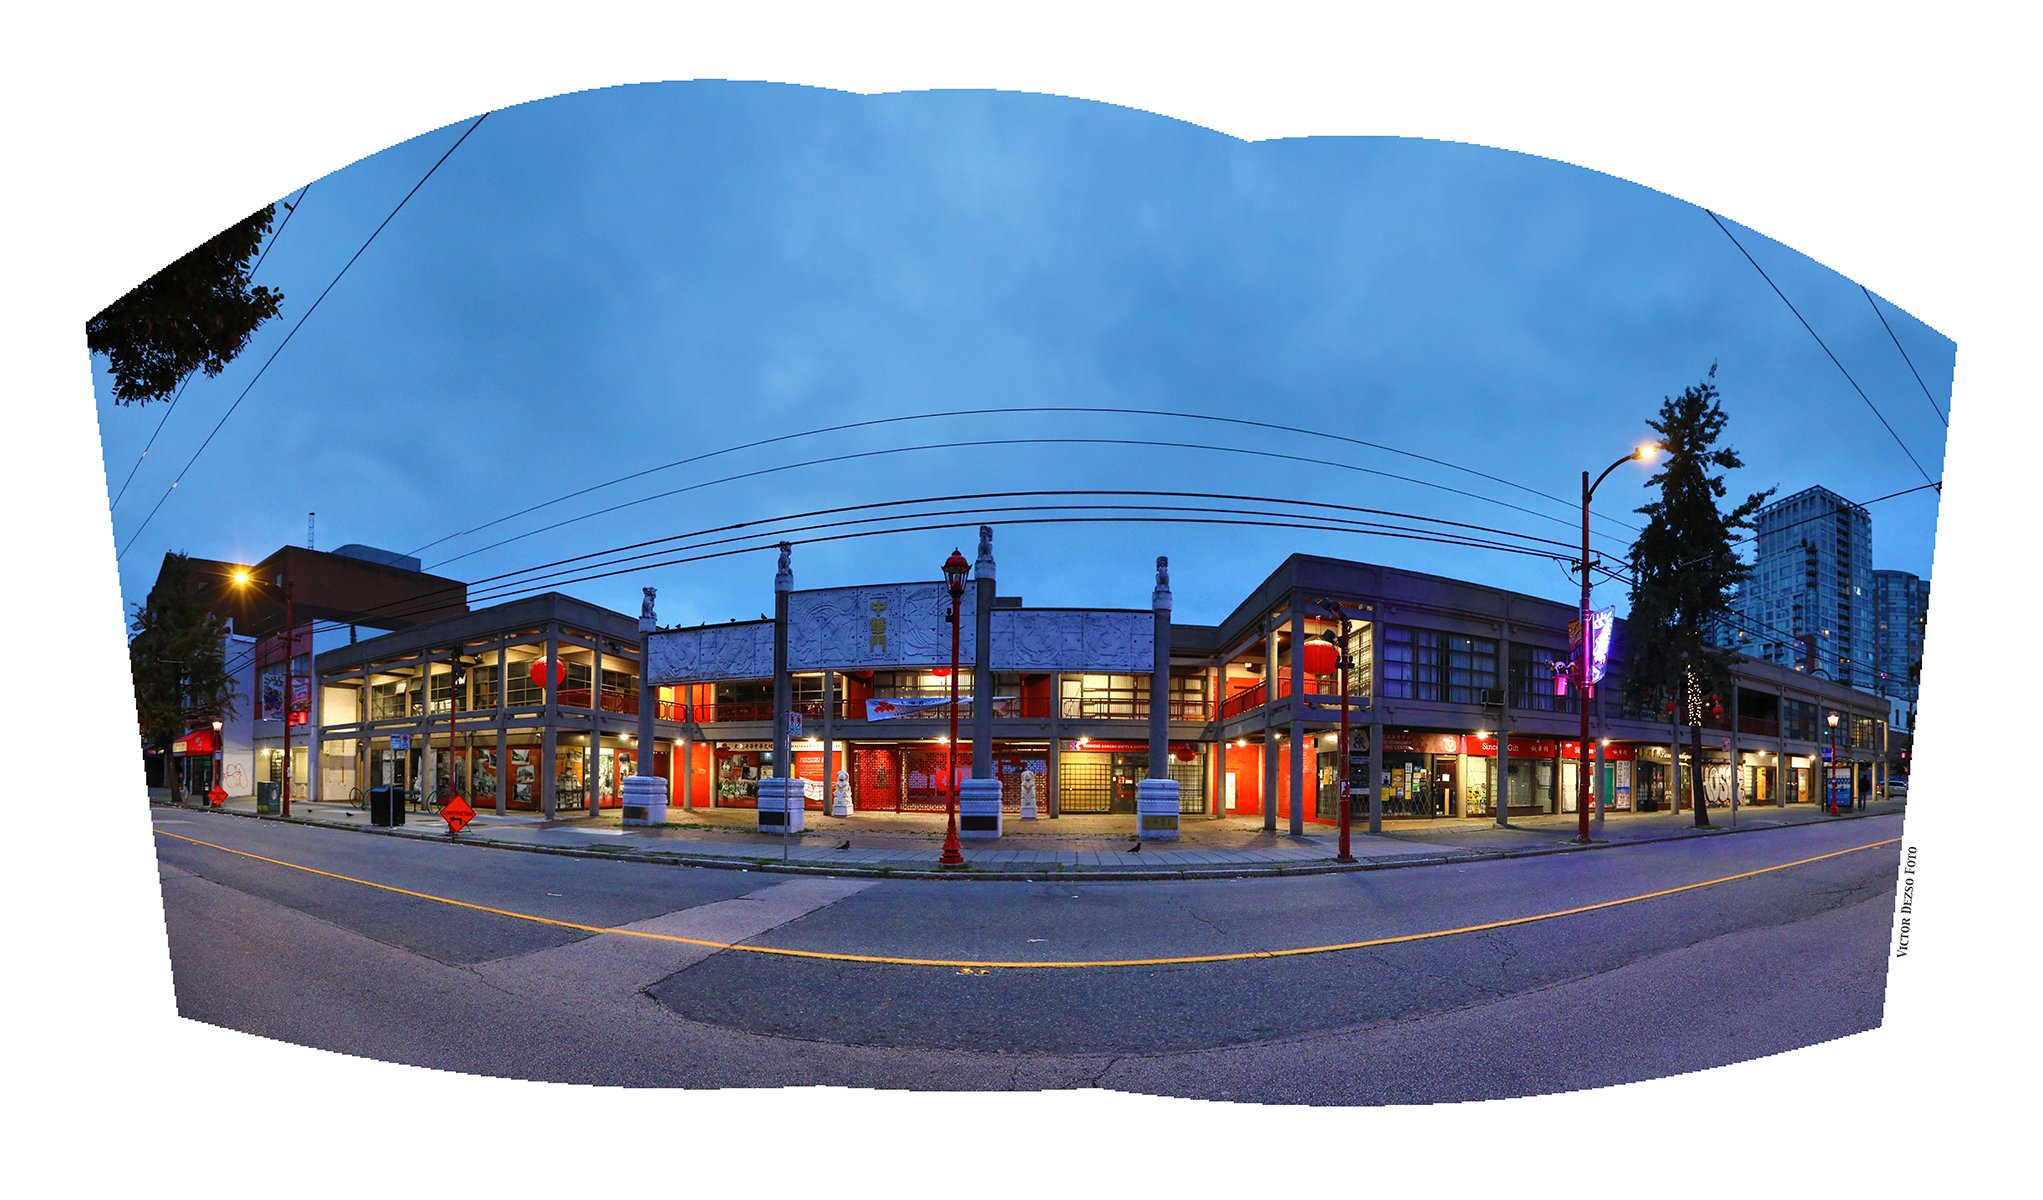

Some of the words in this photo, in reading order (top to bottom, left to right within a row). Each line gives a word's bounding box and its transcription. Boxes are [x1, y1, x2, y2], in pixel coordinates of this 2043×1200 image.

[870, 599, 888, 653] 中華門
[1507, 744, 1519, 752] Gift
